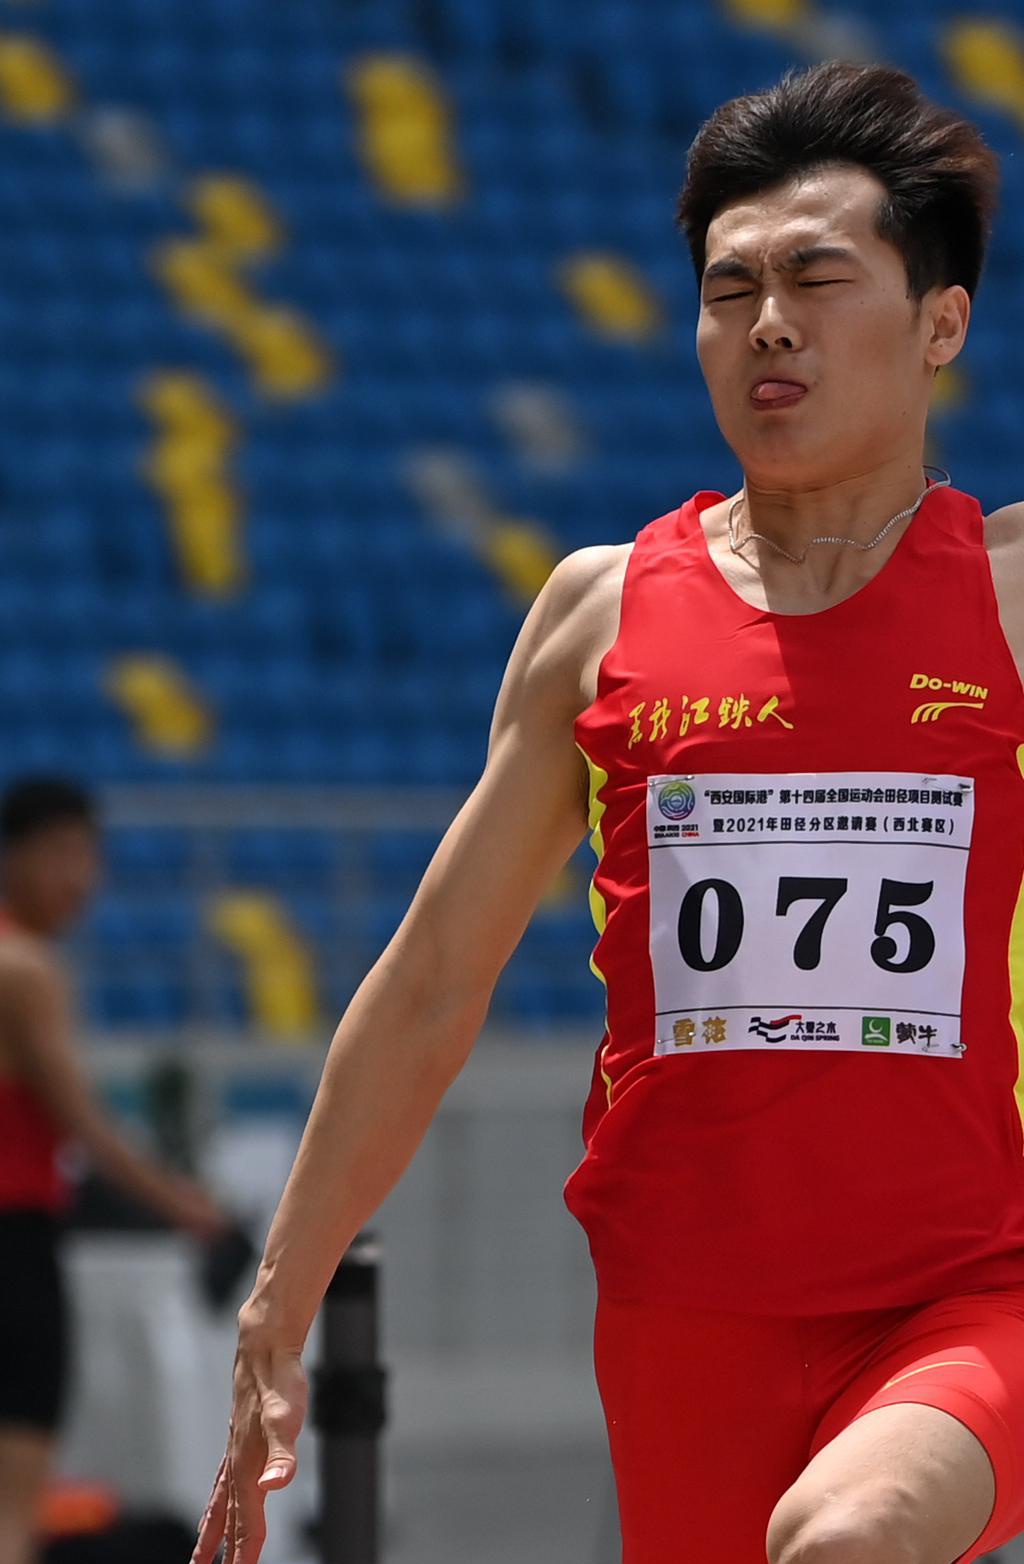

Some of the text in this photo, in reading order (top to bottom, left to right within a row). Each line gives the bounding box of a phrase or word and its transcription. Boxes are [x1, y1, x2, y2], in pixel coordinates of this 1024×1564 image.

[677, 876, 936, 974] 075
[672, 1016, 728, 1047] 雪花
[895, 1021, 938, 1047] 蒙牛
